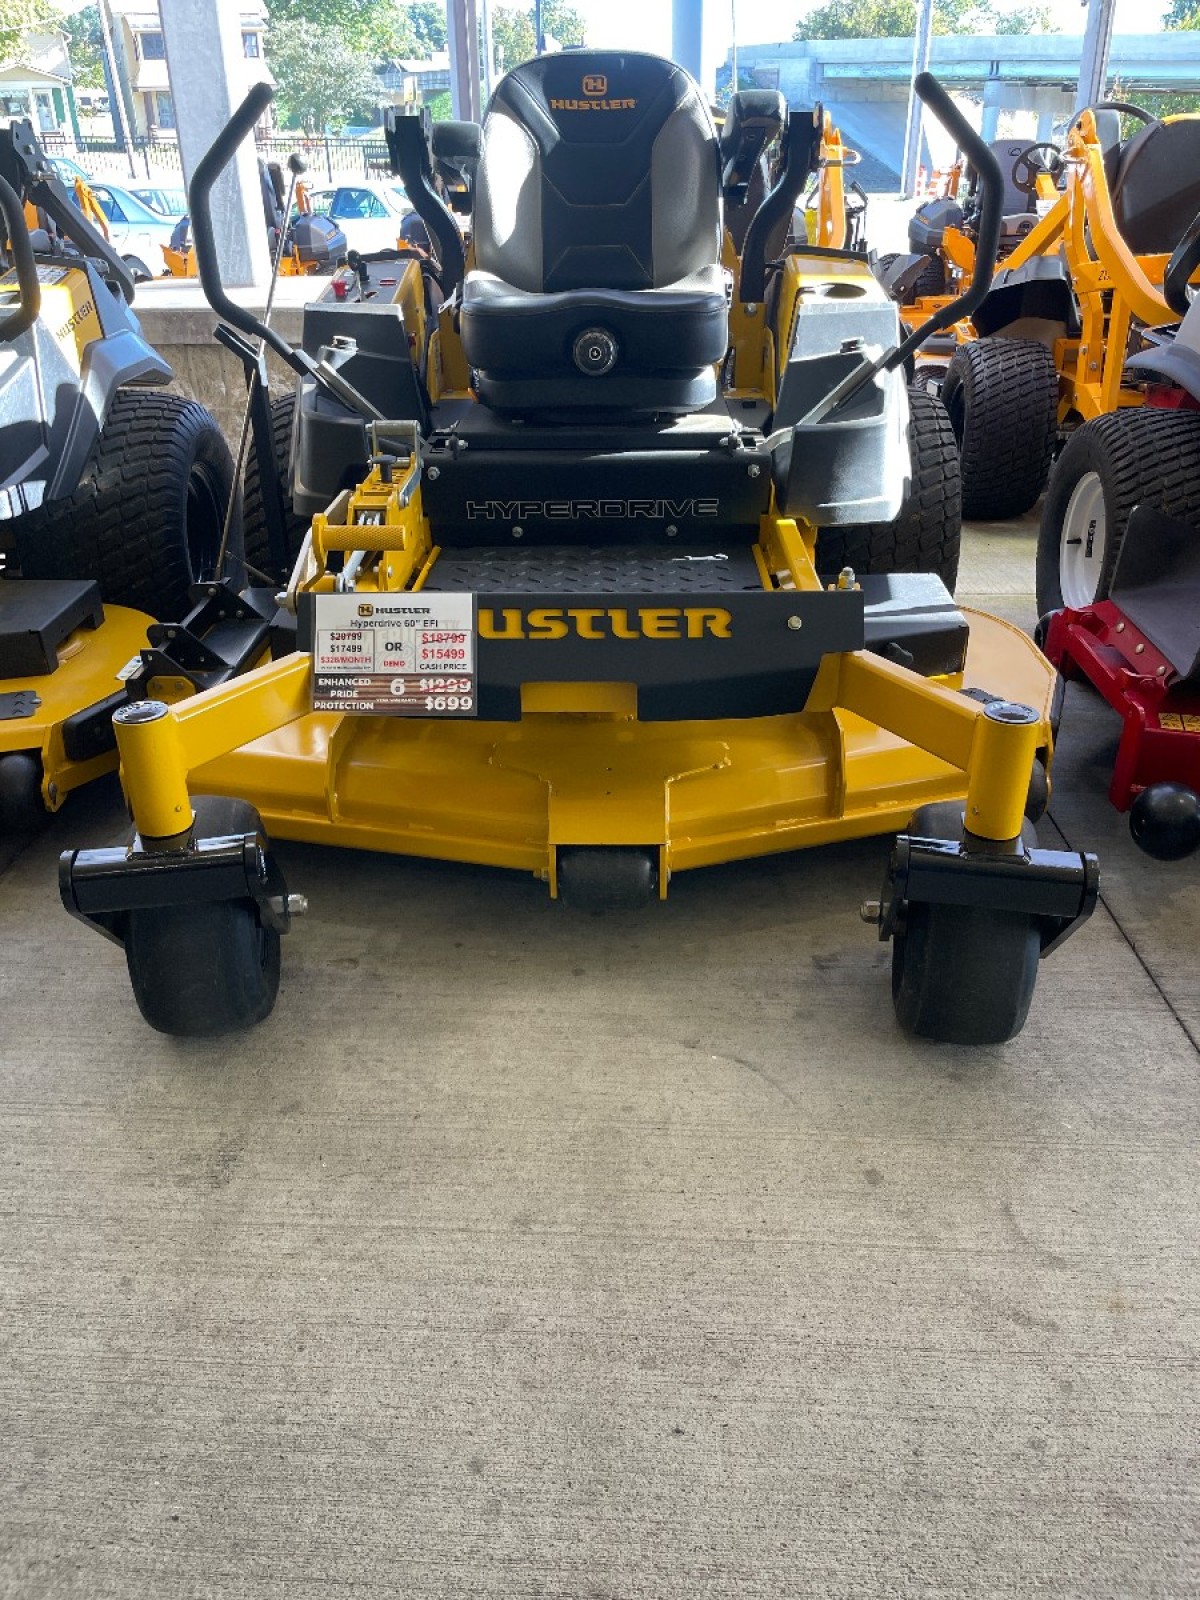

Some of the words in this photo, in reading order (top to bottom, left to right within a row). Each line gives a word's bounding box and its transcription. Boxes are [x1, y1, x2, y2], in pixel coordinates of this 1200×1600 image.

[550, 99, 636, 110] HUSTLER
[466, 499, 719, 519] HYPERDRIVE
[350, 619, 402, 628] Hyperdrive
[423, 619, 438, 627] EFI
[477, 608, 733, 639] USTLER
[421, 632, 466, 644] $18799
[330, 644, 362, 653] $17499
[384, 642, 403, 651] OR
[422, 648, 465, 659] $15499
[318, 678, 372, 686] ENHANCED
[390, 678, 405, 696] 6
[420, 678, 472, 693] $1299
[330, 690, 360, 698] PRIDE
[314, 702, 374, 710] PROTECTION
[425, 695, 472, 711] $699
